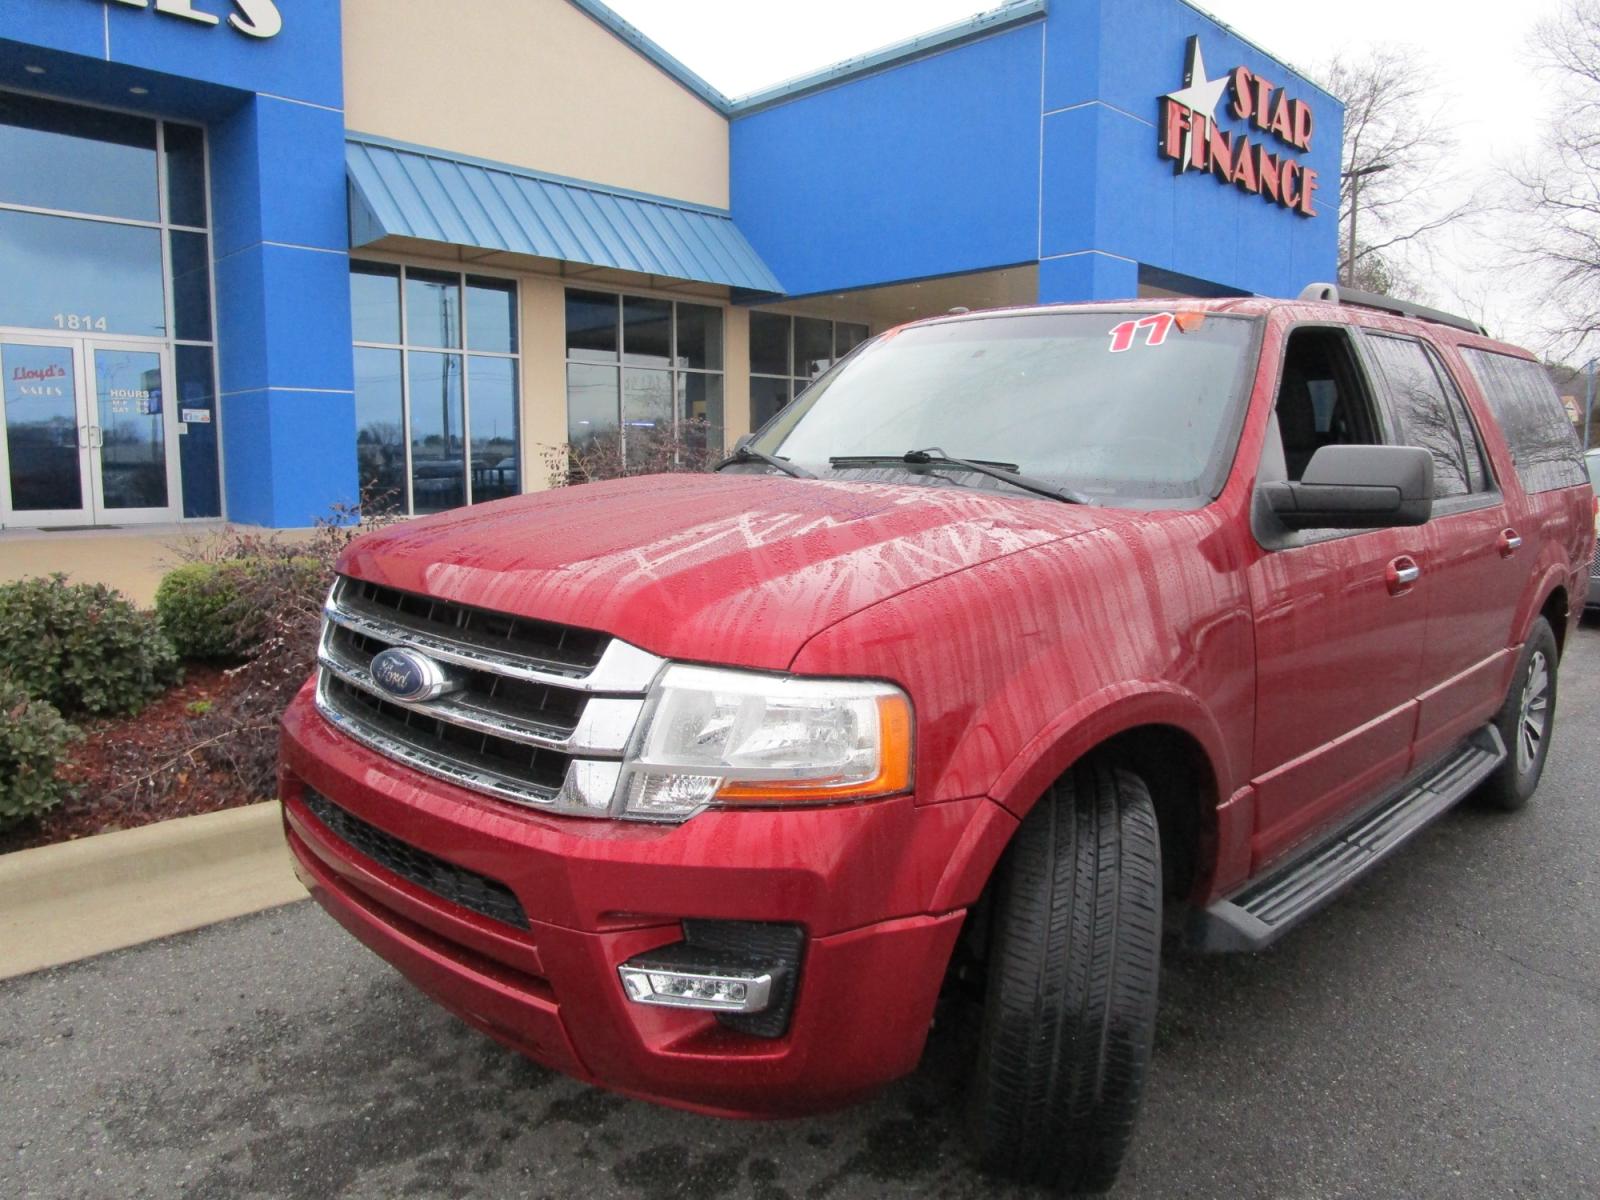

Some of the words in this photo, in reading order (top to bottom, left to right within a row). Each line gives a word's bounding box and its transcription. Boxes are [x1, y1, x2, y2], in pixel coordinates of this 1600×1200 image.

[1231, 66, 1314, 153] STAR
[1161, 98, 1320, 217] FINANCE
[53, 313, 107, 331] 1814
[1108, 311, 1176, 352] 17
[12, 364, 66, 381] Lloyd's
[110, 389, 149, 398] HOURS
[376, 656, 412, 689] Ford
